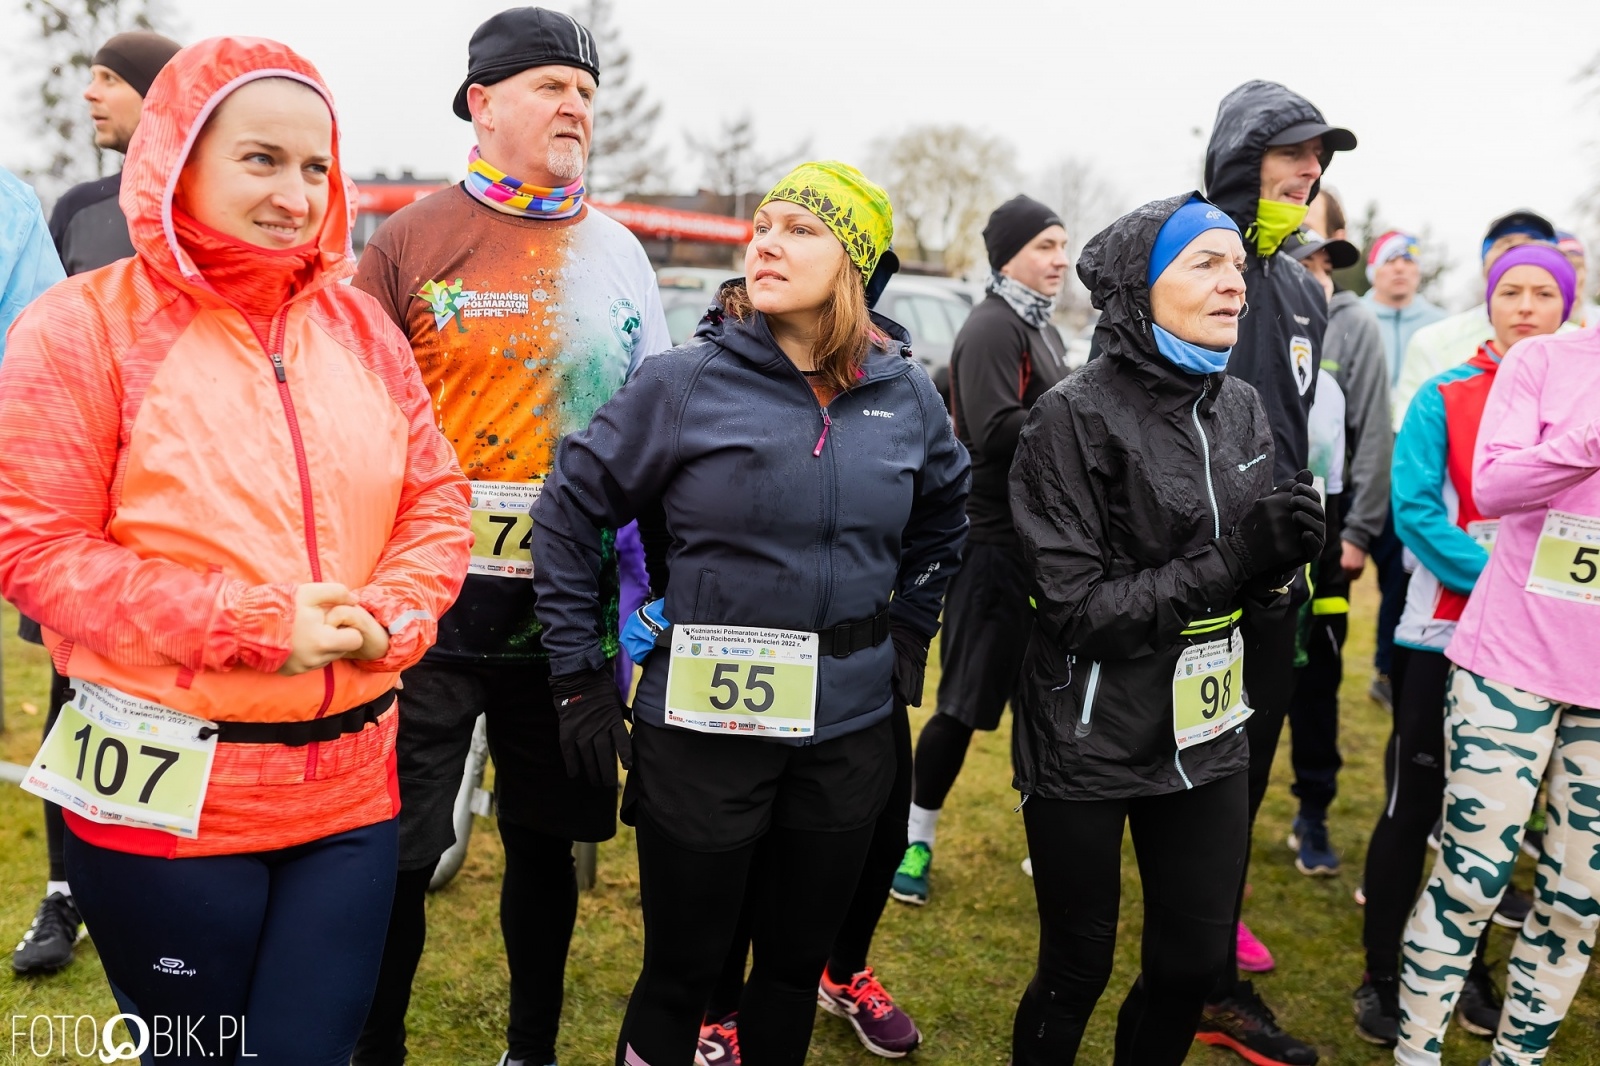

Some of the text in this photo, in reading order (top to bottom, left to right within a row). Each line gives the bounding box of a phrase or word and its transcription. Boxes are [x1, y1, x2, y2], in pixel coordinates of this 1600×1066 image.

[471, 291, 529, 301] KUŹNIAŃSKI
[464, 300, 529, 309] PÓŁMARATON
[463, 308, 510, 318] RAFAMET
[723, 628, 759, 638] Półmaraton
[690, 634, 711, 642] Kuźnia
[747, 637, 752, 645] 9
[709, 663, 775, 713] 55
[1200, 669, 1232, 720] 98
[74, 723, 180, 804] 107
